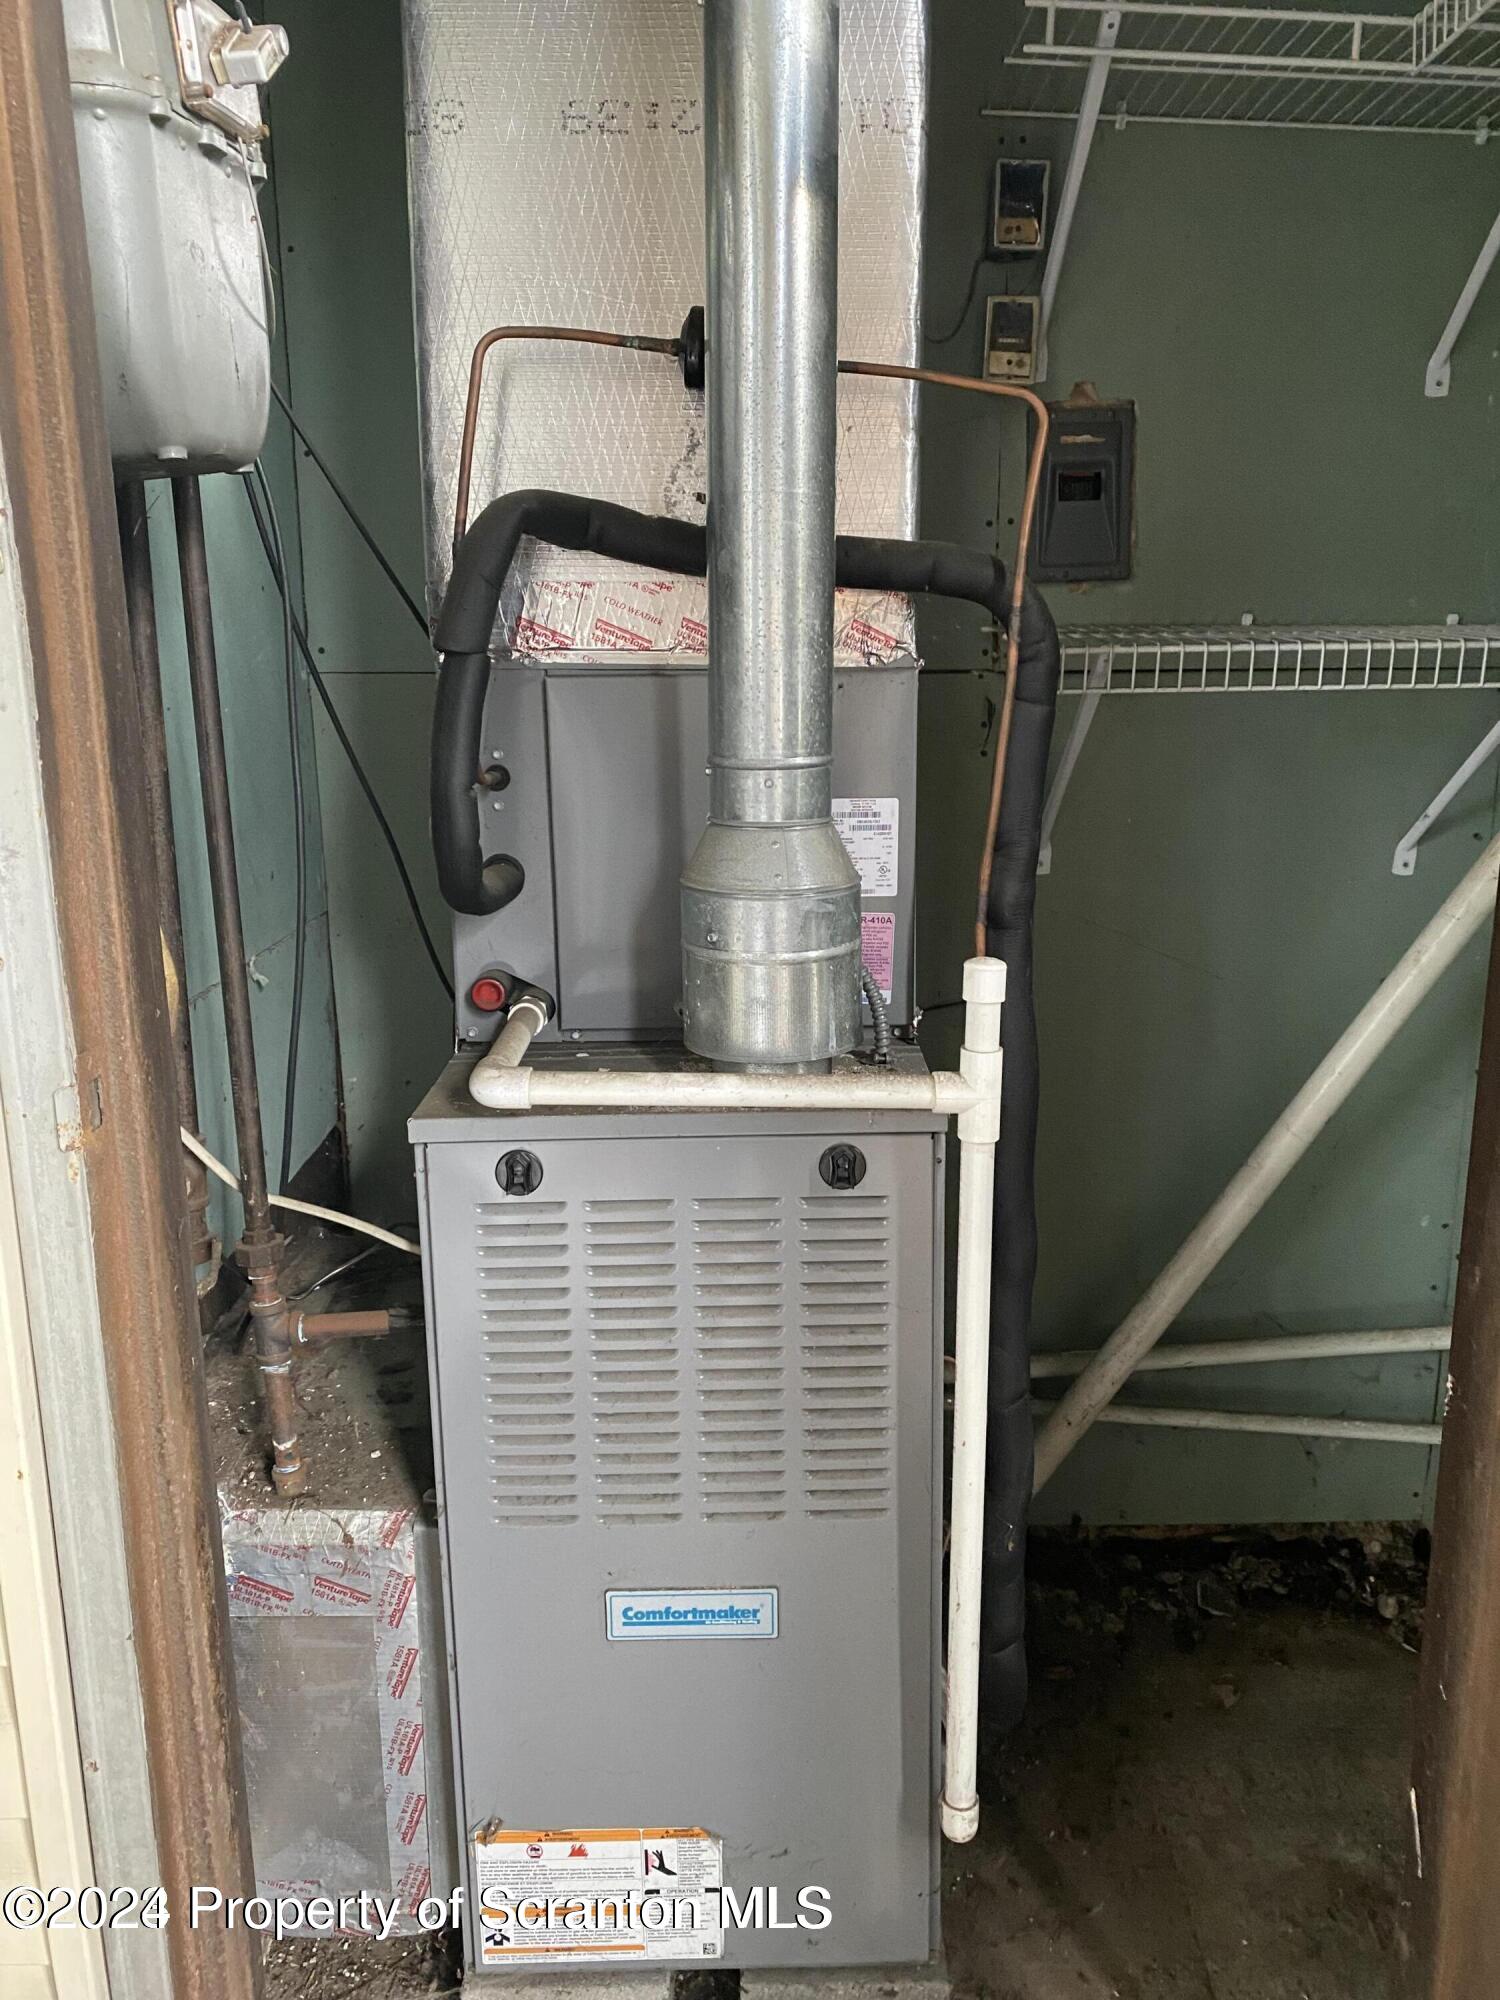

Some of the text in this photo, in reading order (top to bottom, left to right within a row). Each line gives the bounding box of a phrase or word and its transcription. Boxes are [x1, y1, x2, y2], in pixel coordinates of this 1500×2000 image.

[628, 606, 664, 627] WEATHER
[860, 916, 893, 924] R-410A
[622, 1606, 760, 1621] Comfortmaker
